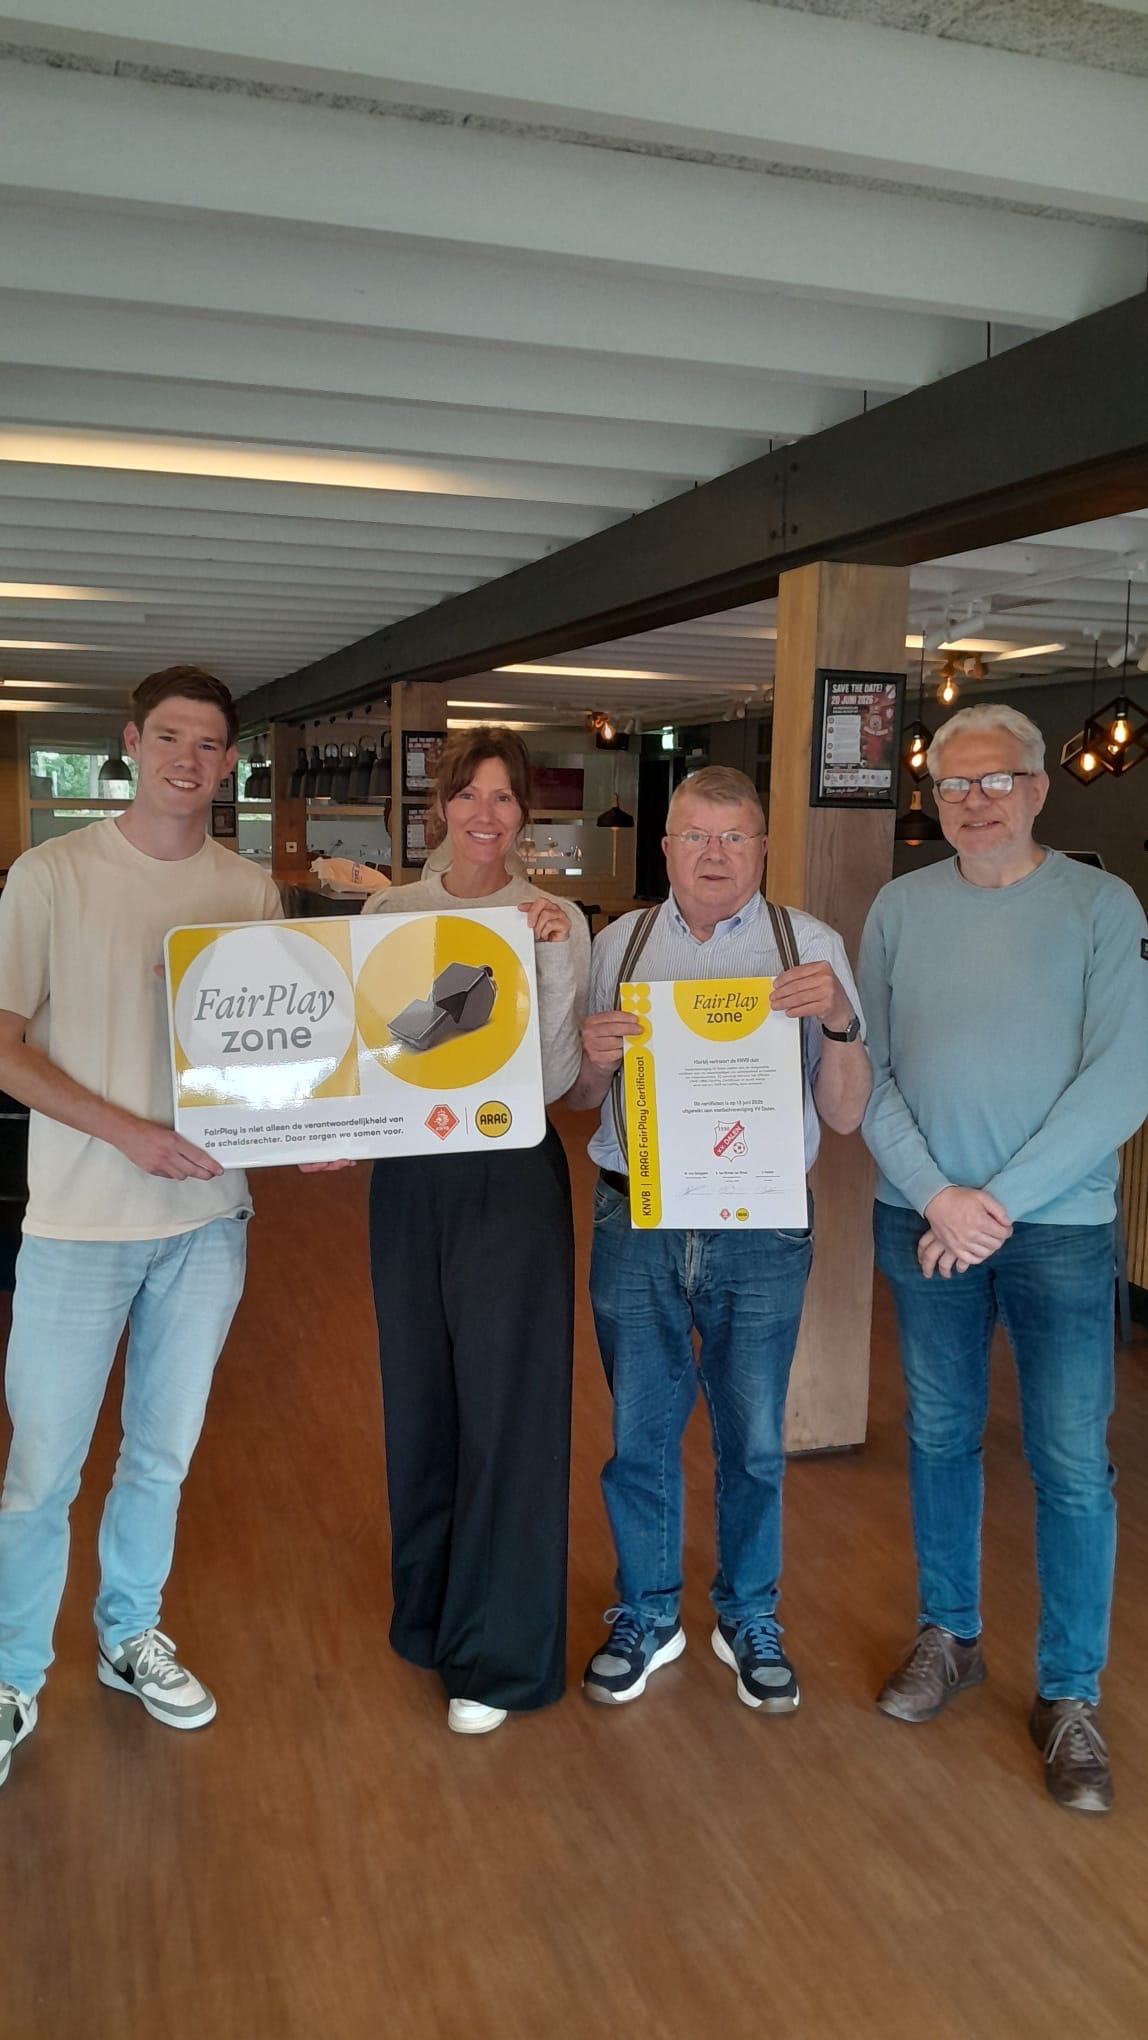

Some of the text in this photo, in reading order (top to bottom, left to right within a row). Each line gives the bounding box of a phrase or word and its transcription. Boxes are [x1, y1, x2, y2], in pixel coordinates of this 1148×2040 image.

[832, 684, 883, 693] SAVE THE DATE!
[831, 695, 840, 704] 20
[841, 695, 857, 704] JUNI
[194, 982, 335, 1022] FairPlay
[693, 993, 758, 1011] FairPlay
[707, 1012, 742, 1023] zone
[222, 1026, 312, 1053] zone
[204, 1127, 238, 1136] FairPlay
[240, 1126, 246, 1134] is
[248, 1125, 264, 1133] niet
[266, 1123, 290, 1132] alleen
[292, 1122, 302, 1130] de
[304, 1116, 387, 1129] verantwoordelijkheid
[480, 1113, 508, 1125] ARAG
[204, 1140, 216, 1148] de
[218, 1137, 283, 1147] scheidsrechter.
[308, 1133, 337, 1141] zorgen
[353, 1129, 381, 1137] samen
[636, 1056, 652, 1216] KNVB ARAG FairPlay Certificaat
[724, 1126, 742, 1145] DALEN
